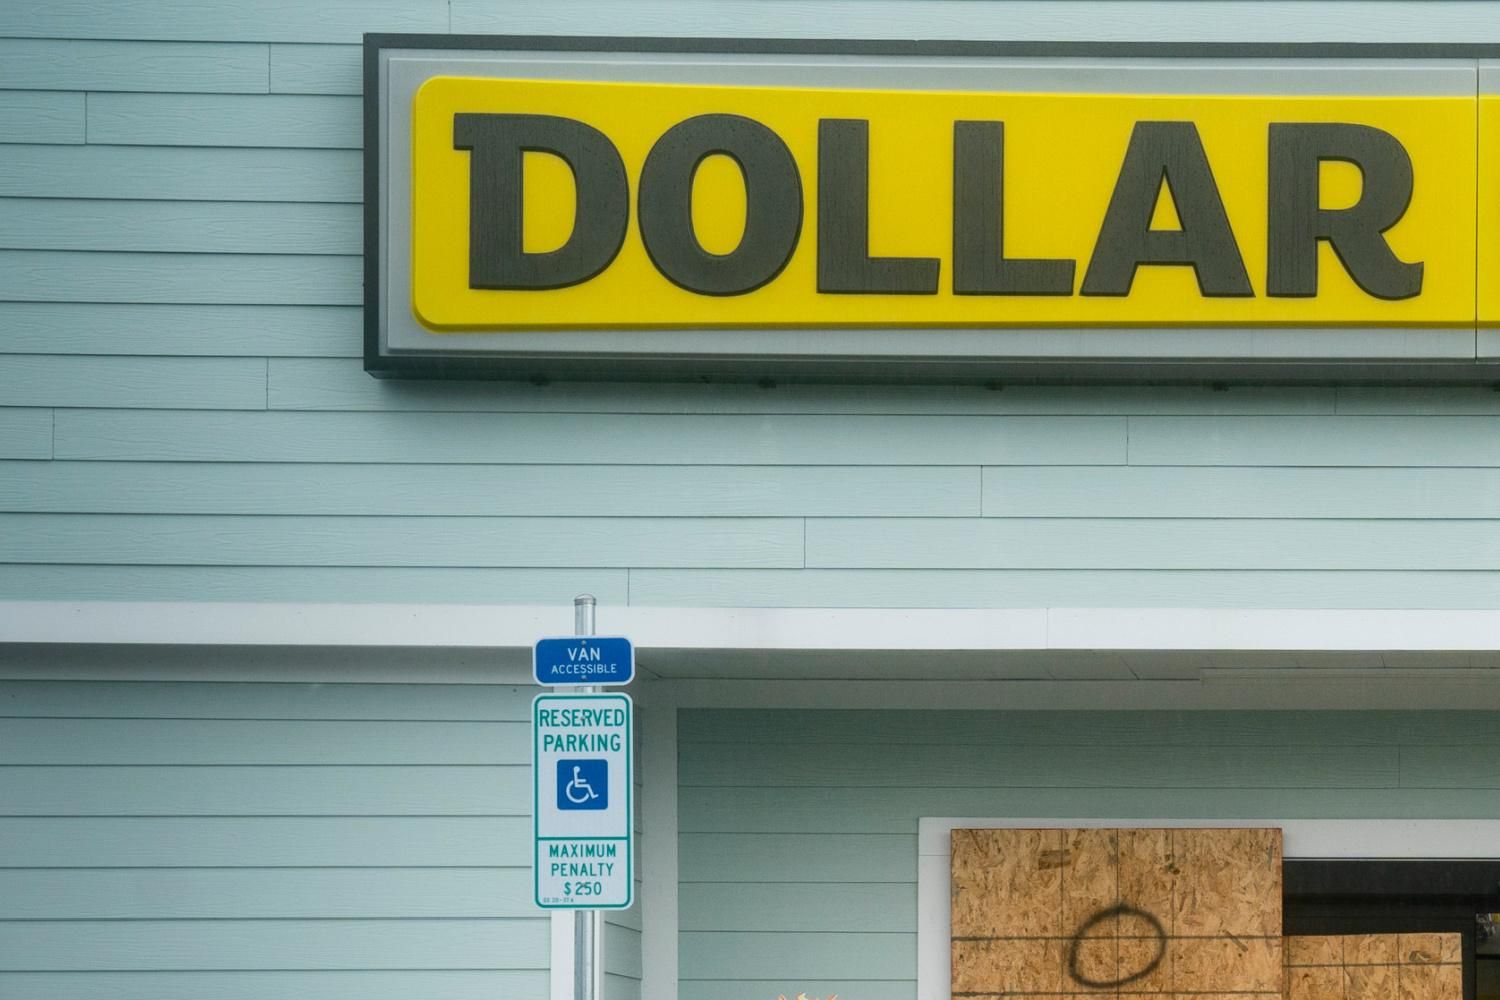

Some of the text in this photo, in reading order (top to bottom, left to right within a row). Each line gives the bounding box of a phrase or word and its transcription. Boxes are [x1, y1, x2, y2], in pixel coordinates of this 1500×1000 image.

[453, 113, 1424, 301] DOLLAR
[568, 647, 600, 661] VAN
[551, 664, 617, 674] ACCESSIBLE
[539, 709, 625, 727] RESERVED
[544, 734, 621, 752] PARKING
[549, 843, 616, 857] MAXIMUM
[551, 863, 614, 877] PENALTY
